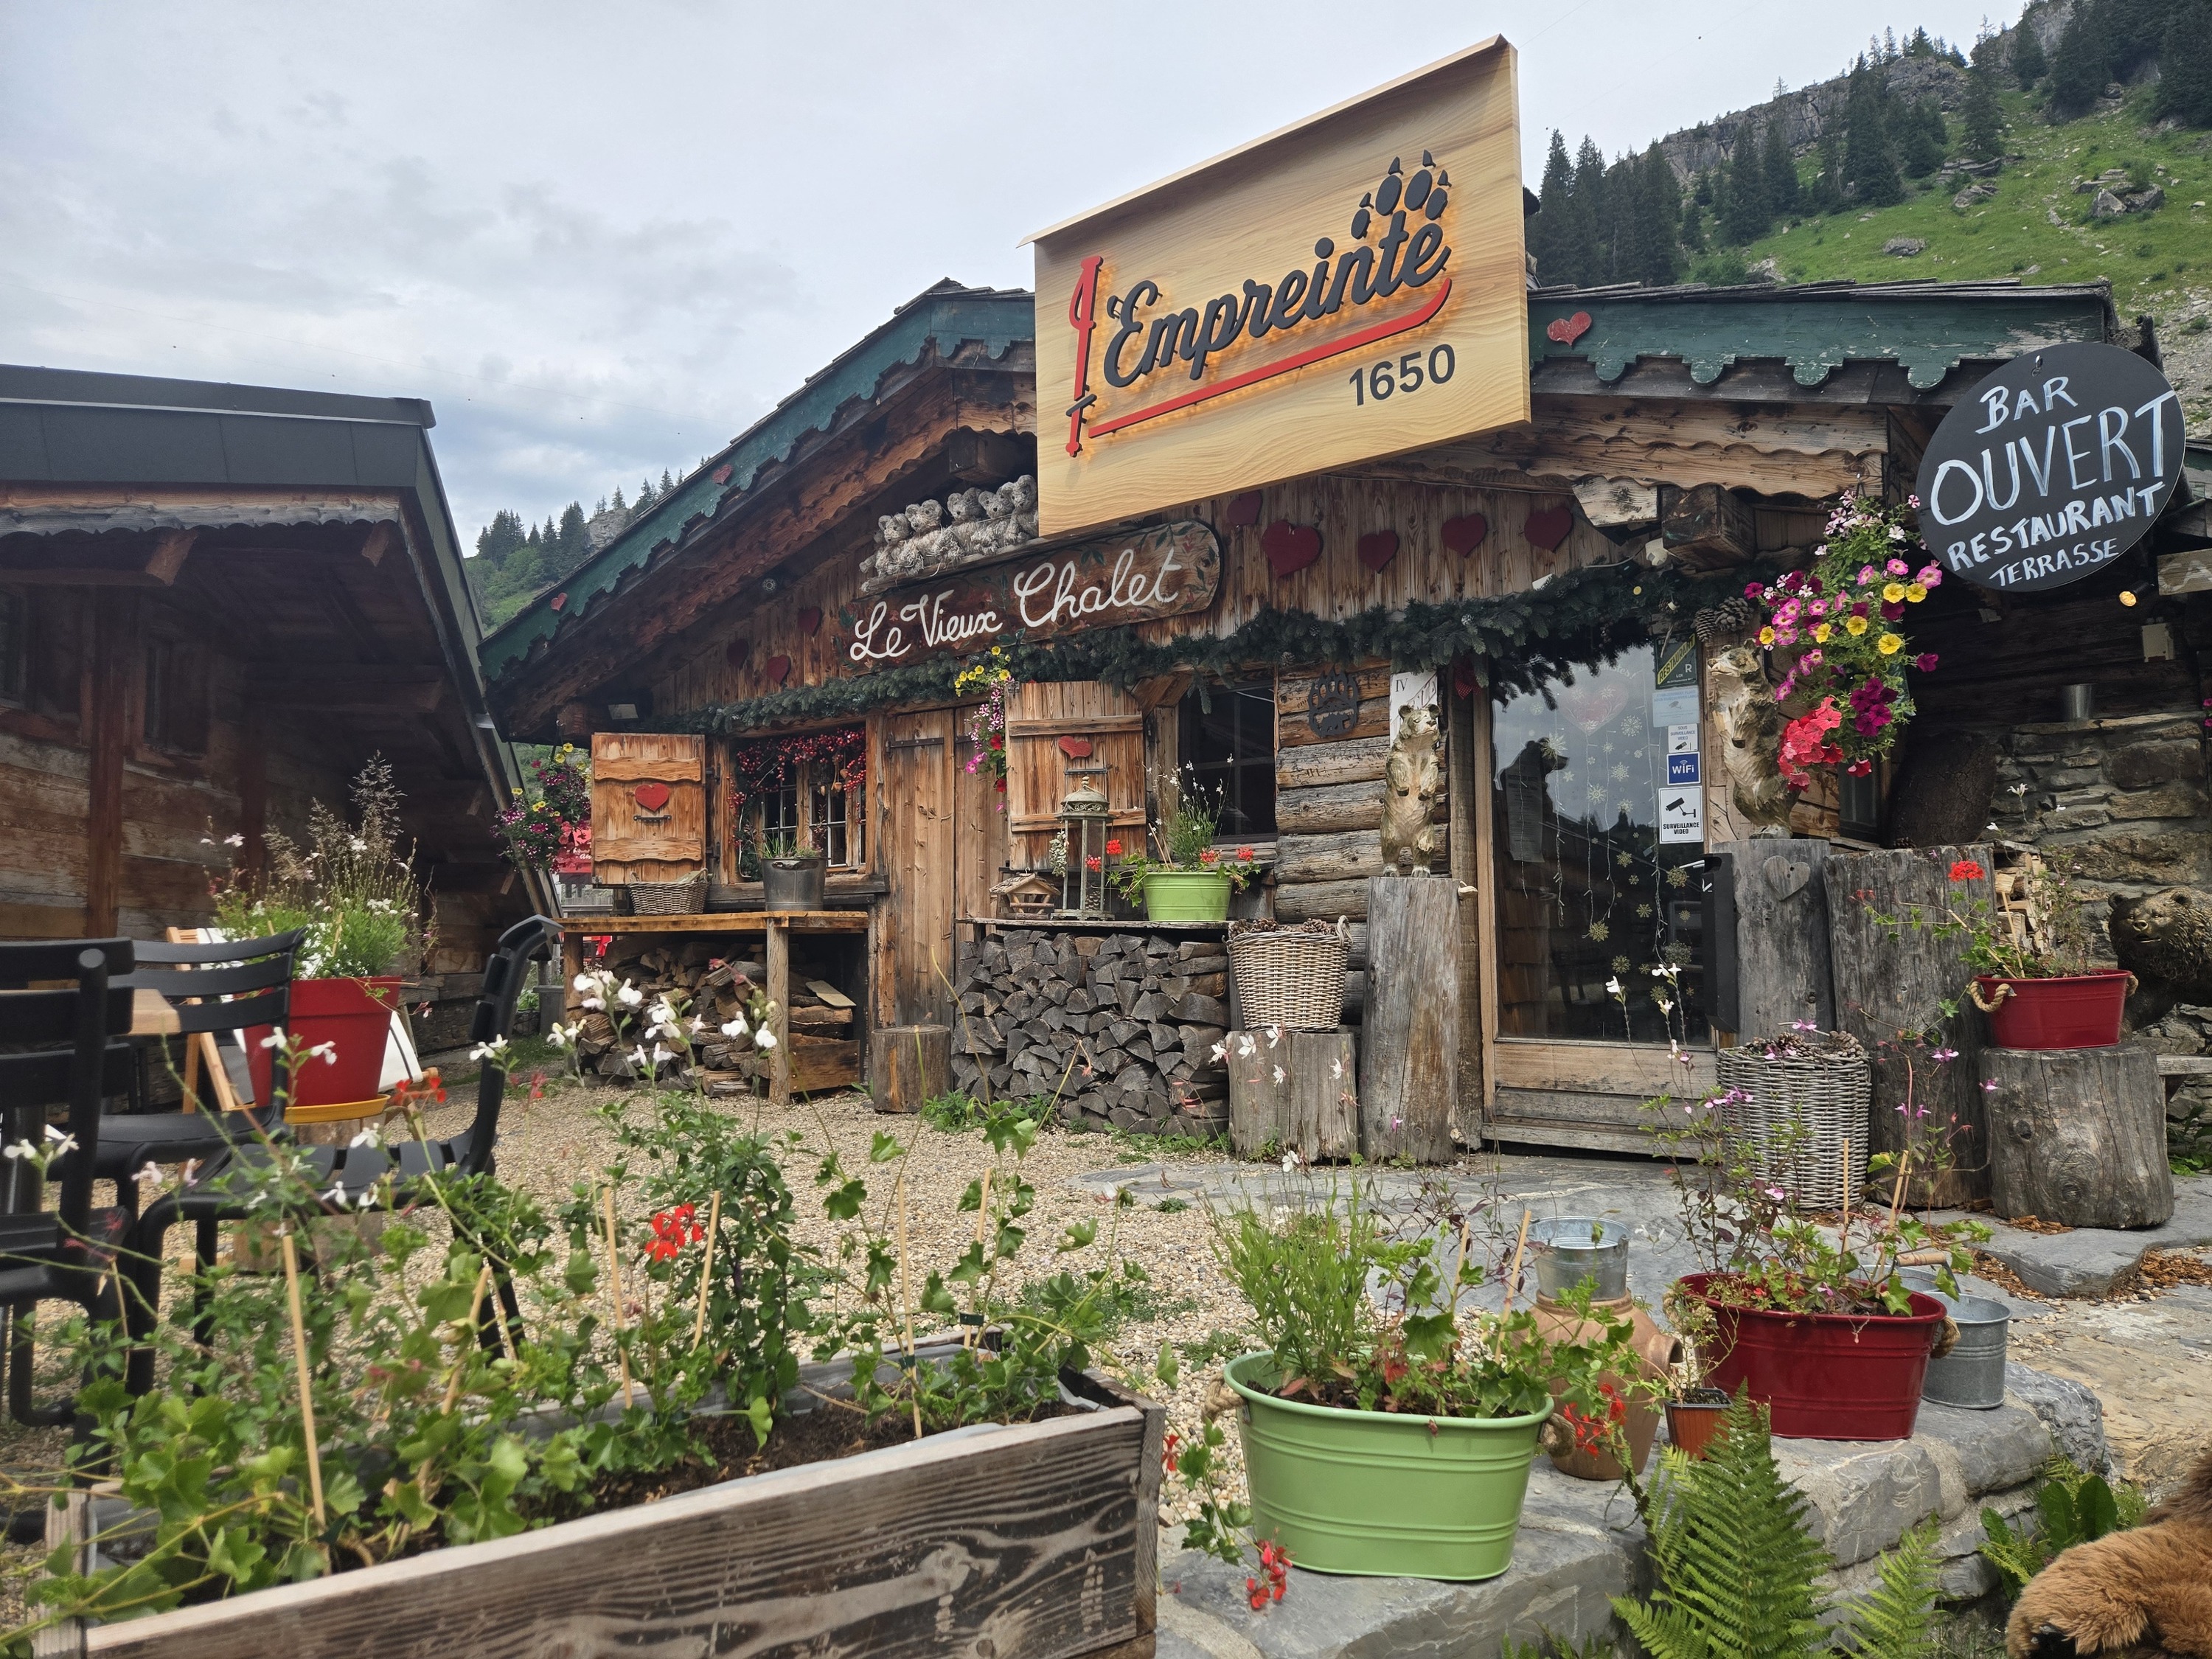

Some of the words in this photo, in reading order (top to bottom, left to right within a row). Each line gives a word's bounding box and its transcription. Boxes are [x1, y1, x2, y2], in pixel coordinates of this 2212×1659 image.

[1348, 344, 1455, 406] 1650
[1975, 376, 2078, 434] BAR
[1930, 390, 2176, 525] OUVERT
[1947, 481, 2166, 572] RESTAURANT
[1989, 538, 2119, 587] TERRASSE
[850, 600, 911, 661] Le
[900, 590, 1003, 647] Vieux
[1014, 547, 1182, 628] Chalet
[1395, 678, 1408, 692] IV
[1658, 635, 1695, 683] RESTAURANT
[1685, 664, 1692, 672] R
[1663, 821, 1700, 830] SURVEILLANCE
